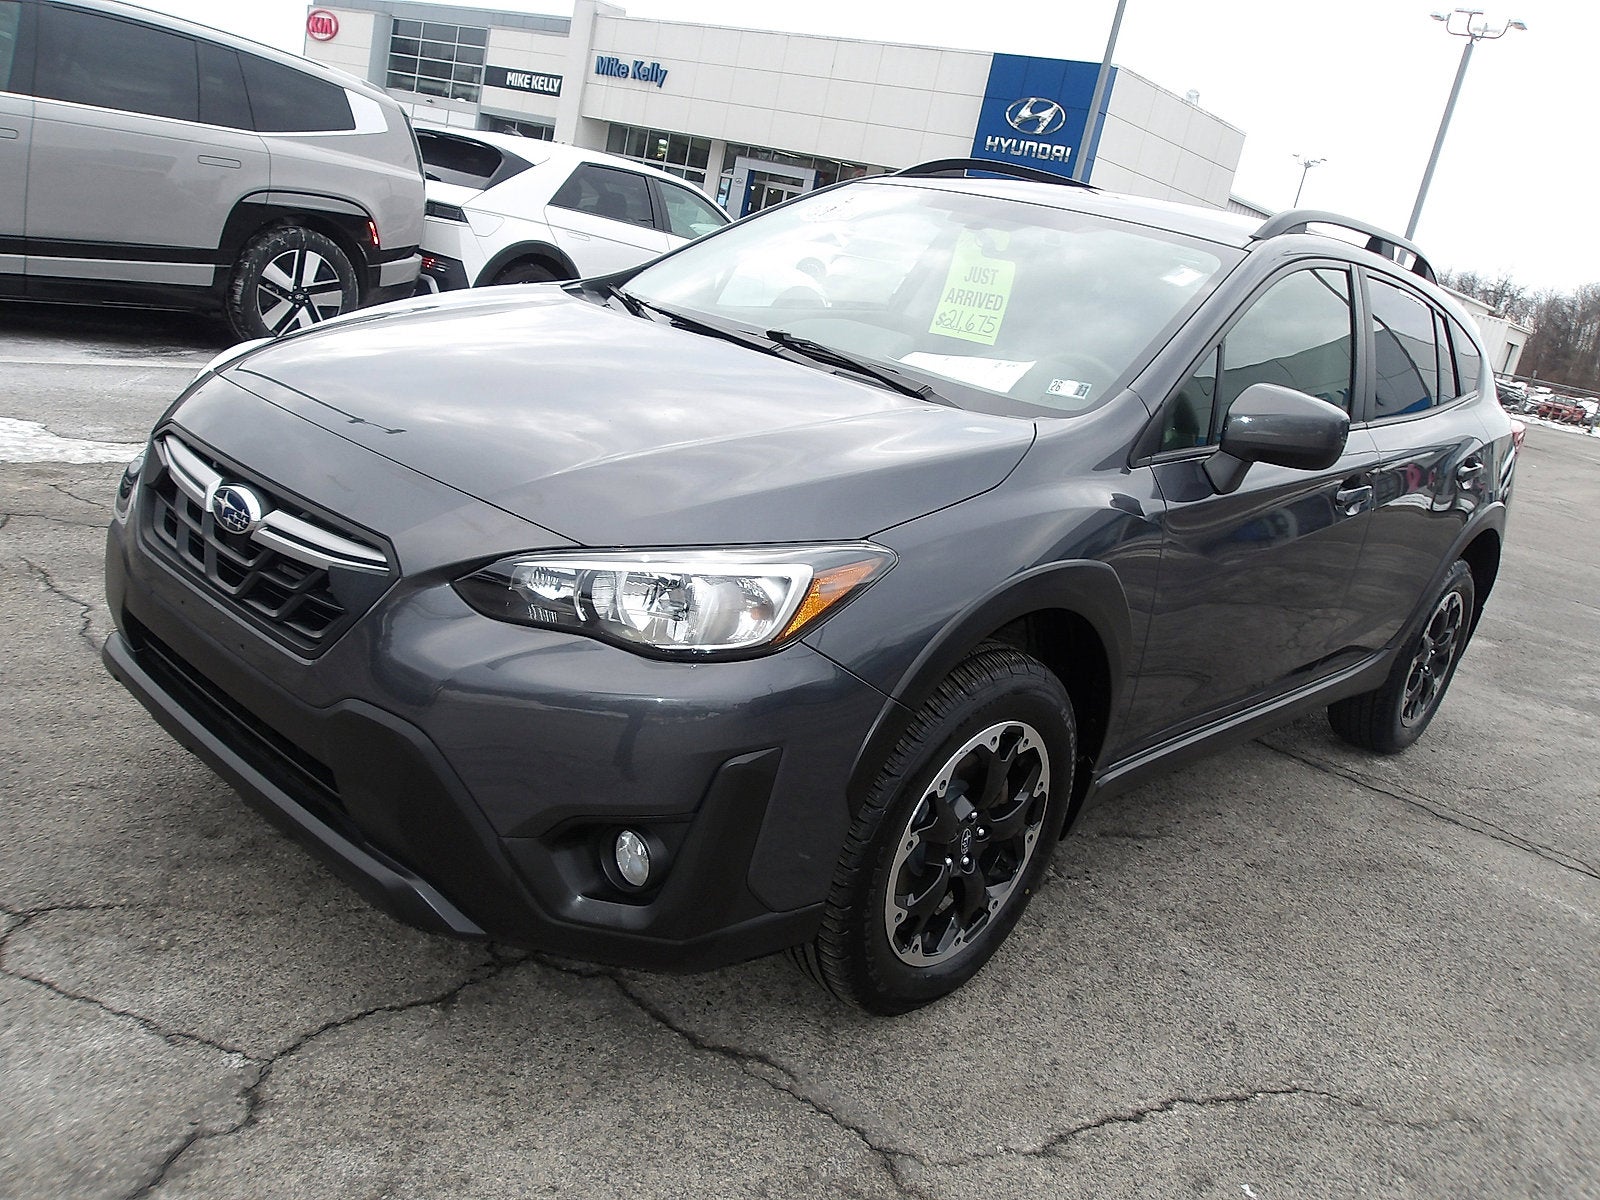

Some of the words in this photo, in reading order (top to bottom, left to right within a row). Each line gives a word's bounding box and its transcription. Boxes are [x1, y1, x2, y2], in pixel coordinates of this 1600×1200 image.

[310, 15, 332, 35] KIA
[506, 71, 531, 89] MIKE
[531, 75, 561, 93] KELLY
[595, 55, 629, 79] Mike
[631, 59, 668, 88] Kelly
[985, 135, 1072, 163] HYUNDAI
[964, 266, 999, 286] JUST
[945, 288, 1004, 312] ARRIVED
